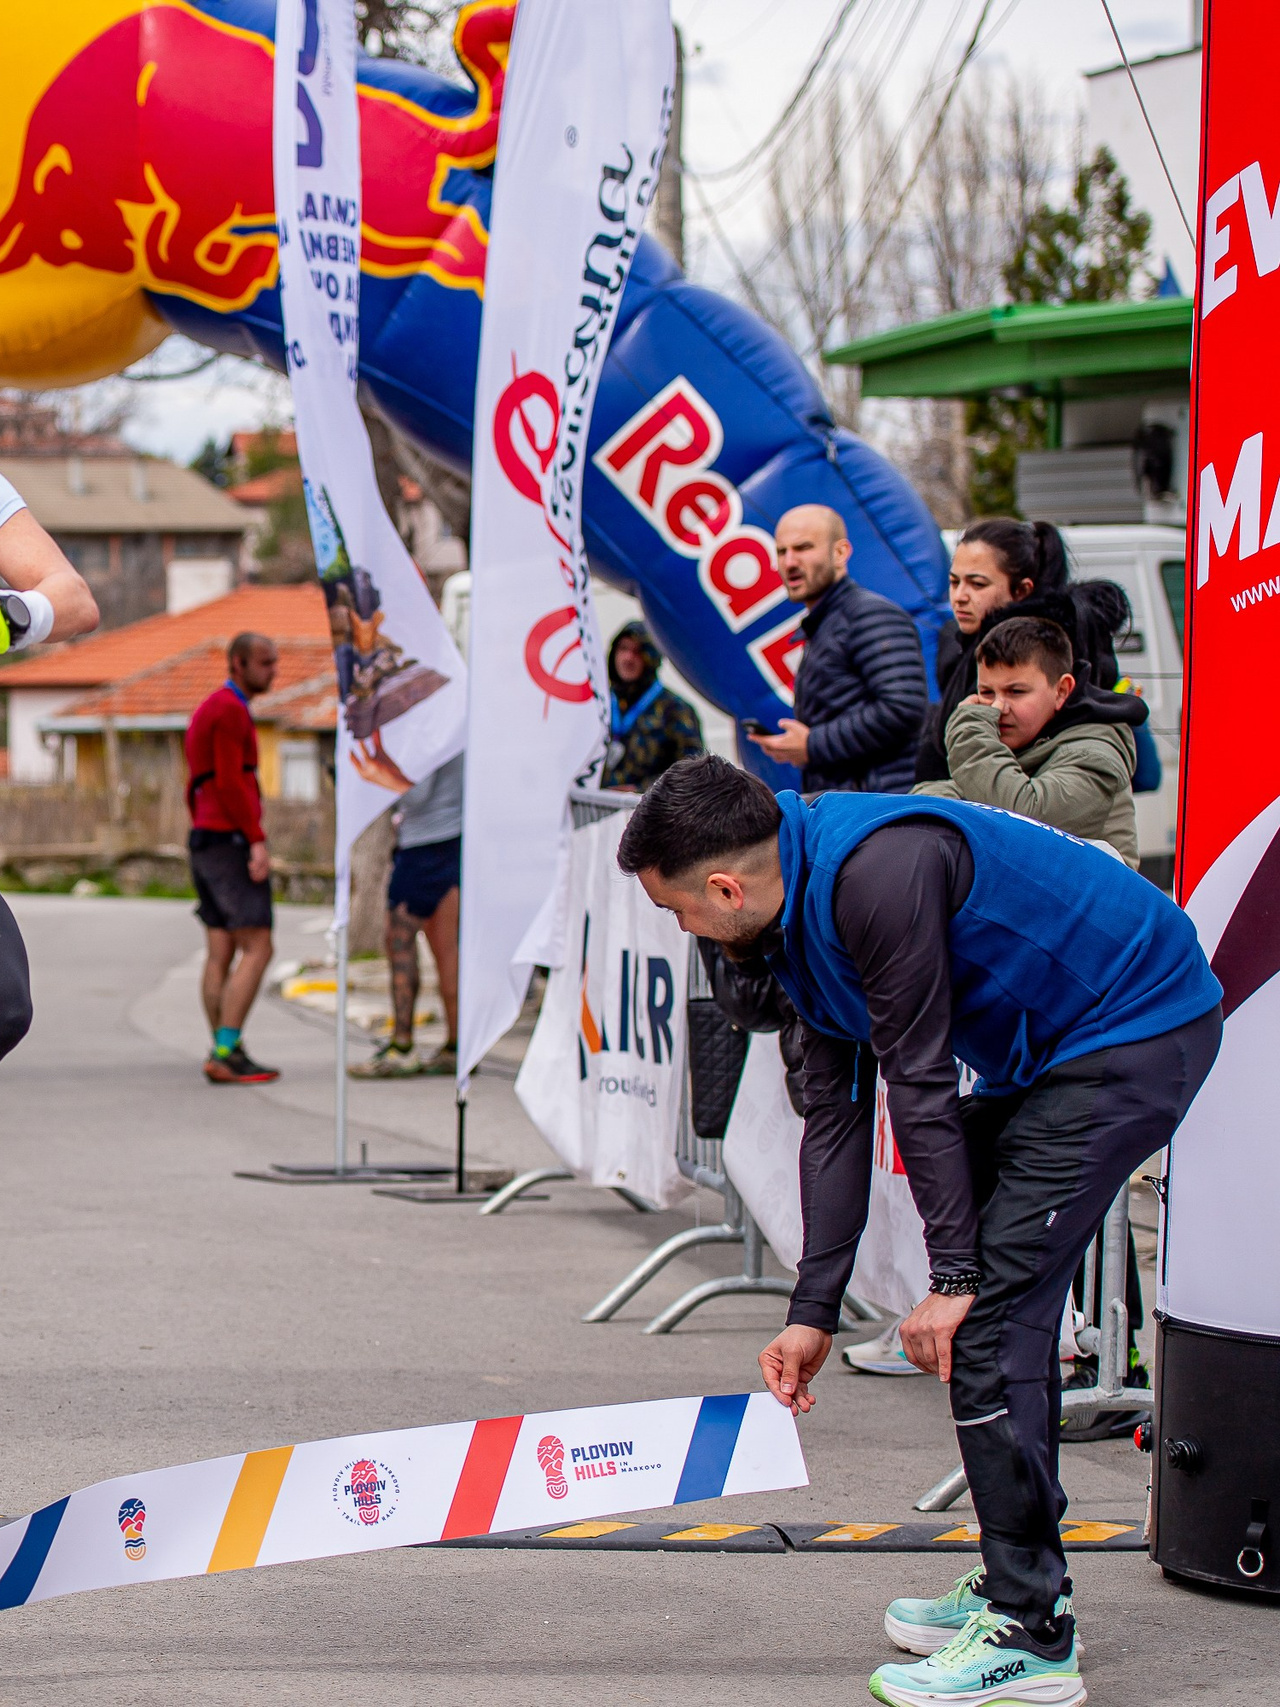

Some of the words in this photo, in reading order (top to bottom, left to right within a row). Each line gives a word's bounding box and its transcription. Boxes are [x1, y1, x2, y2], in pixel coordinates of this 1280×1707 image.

[570, 1441, 633, 1463] PLOVDIV
[574, 1461, 618, 1481] HILLS
[621, 1463, 662, 1473] MARKOVO
[344, 1480, 386, 1495] PLOVDIV
[353, 1494, 381, 1507] HILLS
[981, 1659, 1026, 1689] HOKA
